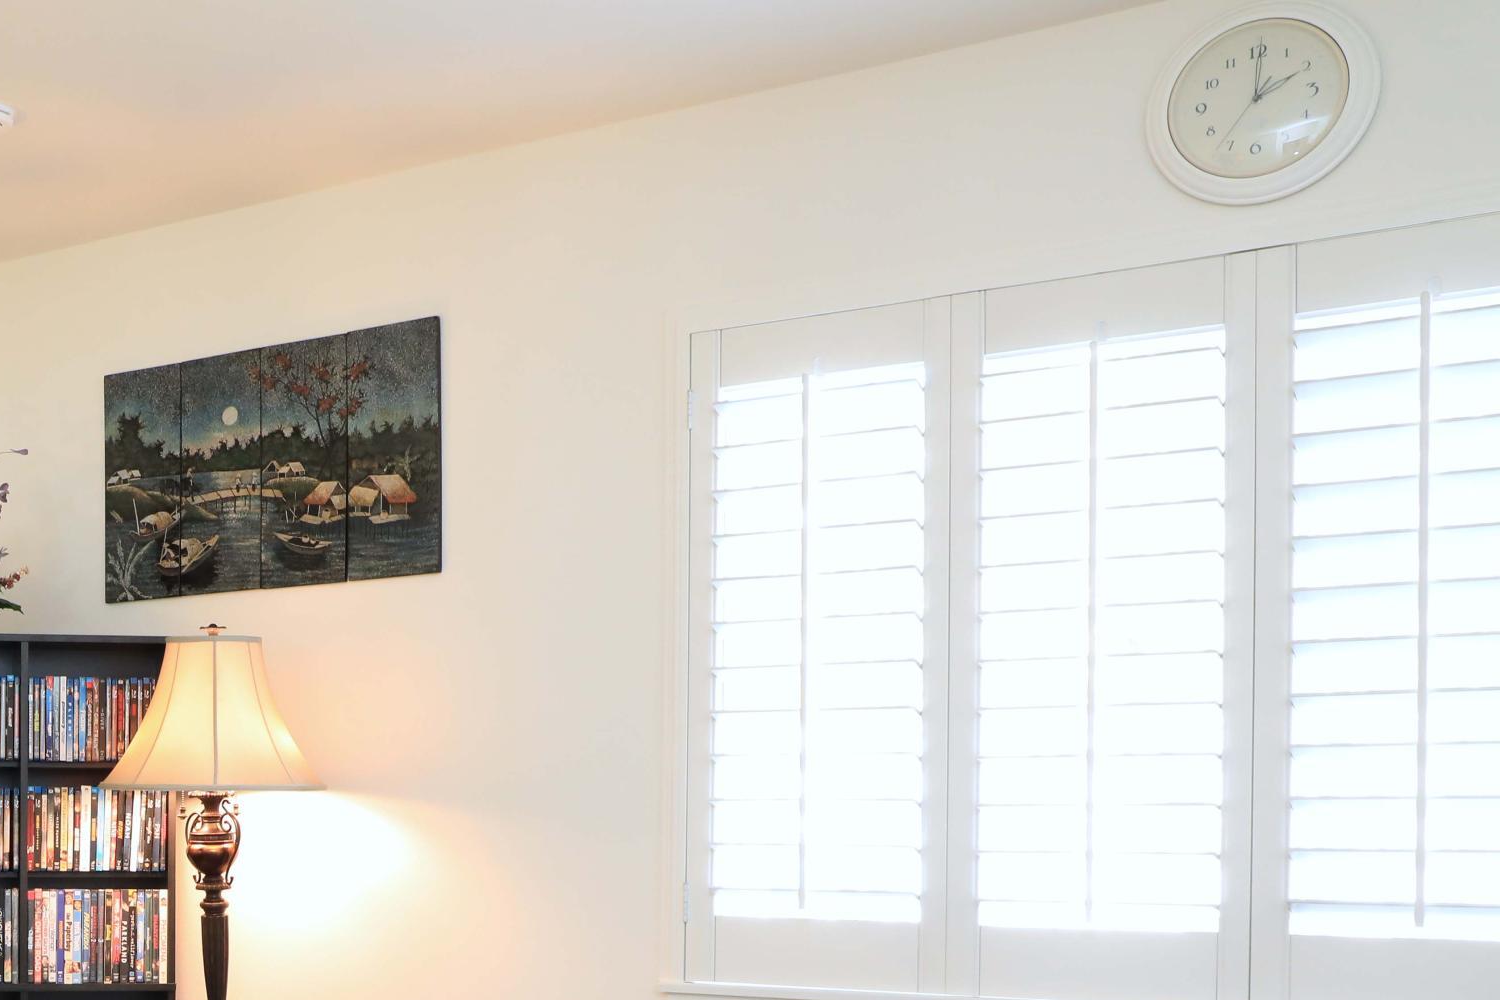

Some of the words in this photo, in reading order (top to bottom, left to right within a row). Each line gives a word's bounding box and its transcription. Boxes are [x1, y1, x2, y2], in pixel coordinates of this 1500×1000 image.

[1249, 44, 1268, 60] 12
[1284, 48, 1289, 58] 1
[1225, 59, 1236, 69] 11
[1301, 60, 1312, 71] 2
[1205, 78, 1219, 90] 10
[1306, 81, 1319, 97] 3
[1206, 126, 1216, 136] 8
[64, 920, 73, 952] Paperboy
